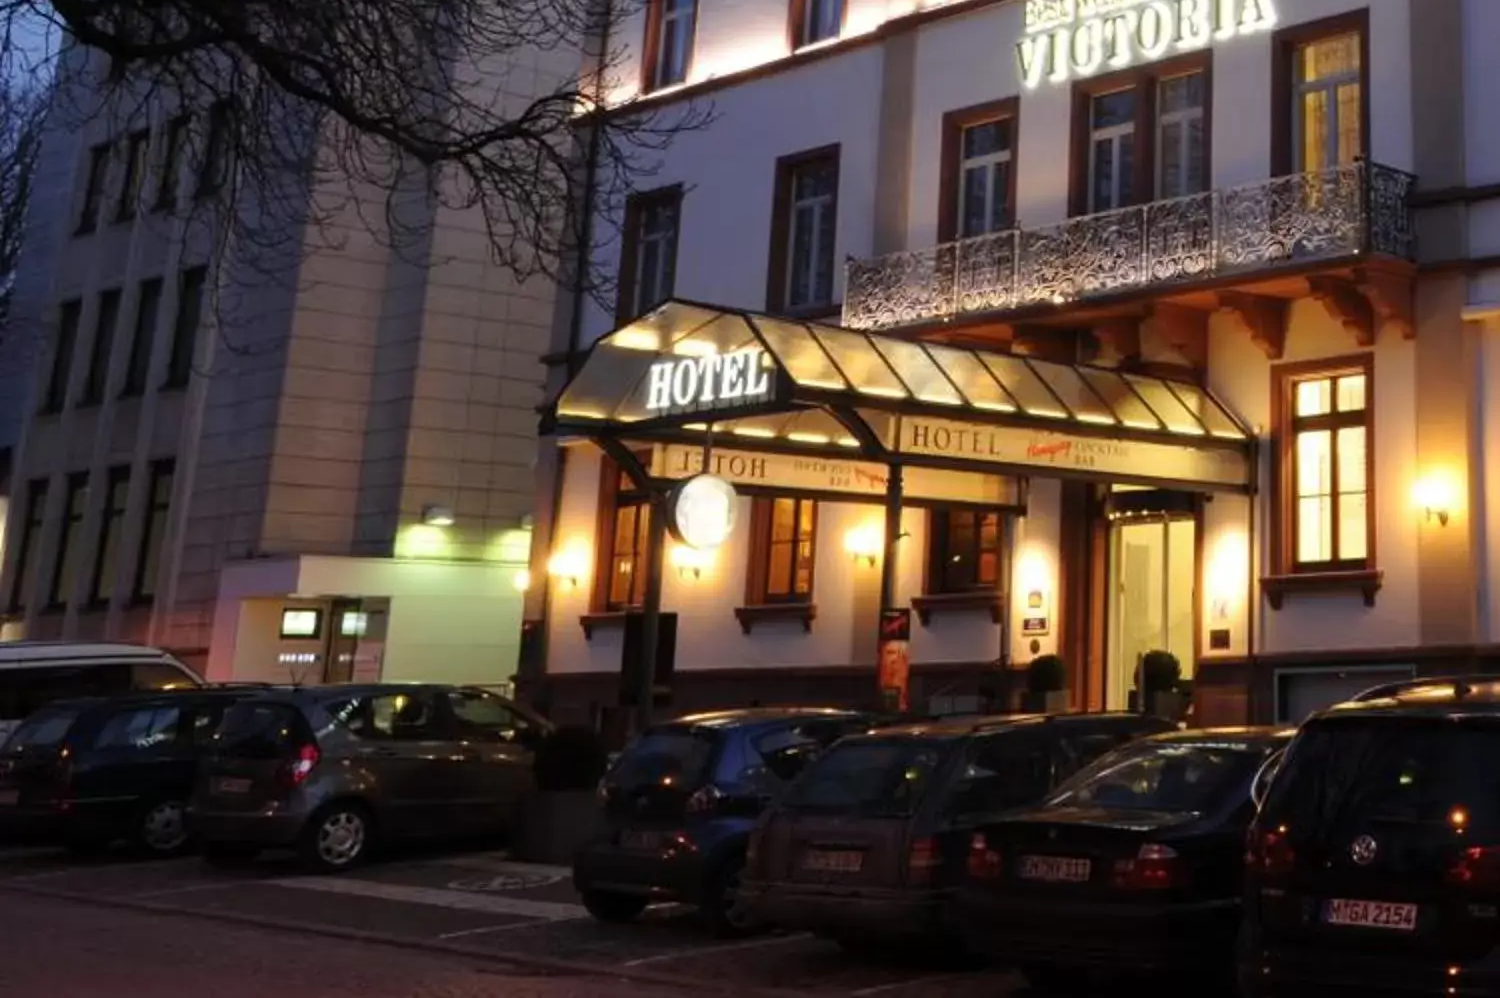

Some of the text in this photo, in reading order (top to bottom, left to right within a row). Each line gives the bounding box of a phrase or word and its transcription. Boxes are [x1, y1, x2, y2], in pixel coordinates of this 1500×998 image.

[646, 348, 769, 410] HOTEL
[911, 423, 1002, 457] HOTEL
[1372, 904, 1414, 926] 2154
